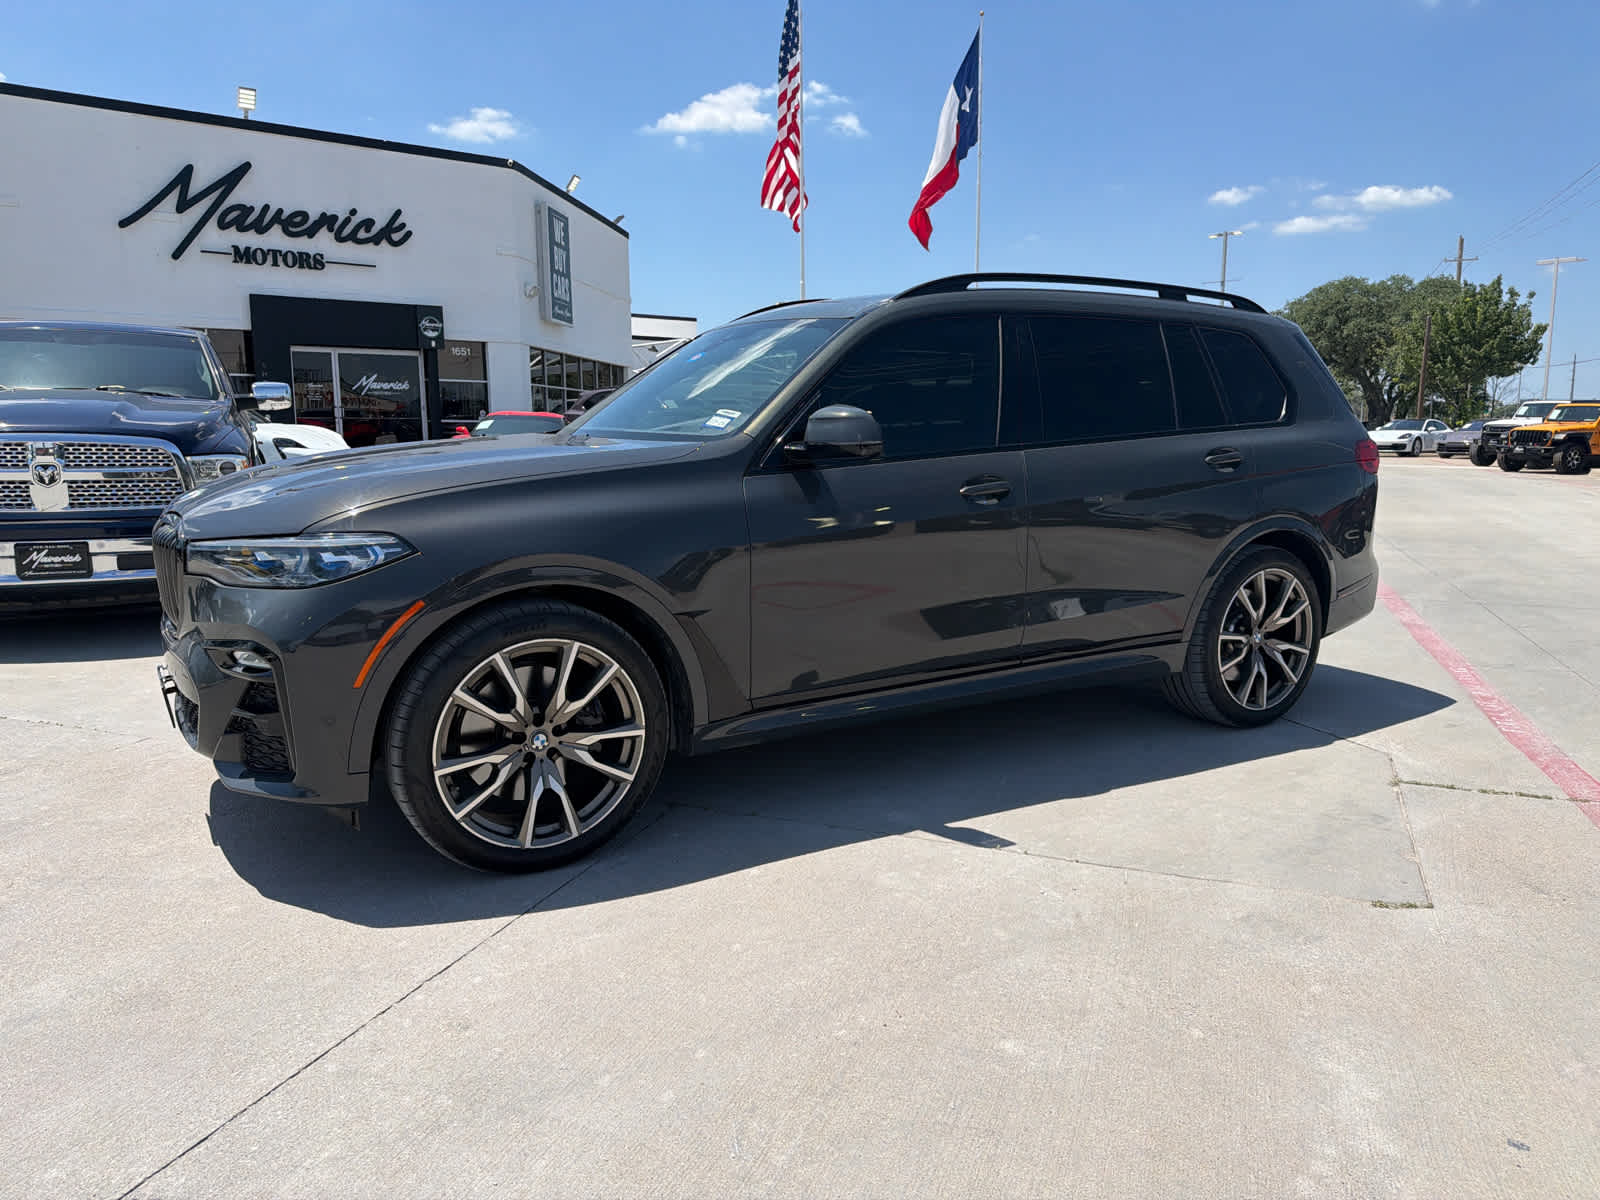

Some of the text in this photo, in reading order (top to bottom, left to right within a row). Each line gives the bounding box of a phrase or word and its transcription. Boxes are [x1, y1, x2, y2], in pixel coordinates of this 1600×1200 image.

[118, 161, 413, 260] Maverick
[553, 217, 565, 245] WE
[231, 245, 326, 270] MOTORS
[553, 246, 567, 274] BUY
[553, 273, 570, 301] CARS
[451, 347, 471, 356] 1651
[352, 374, 409, 395] Maverick
